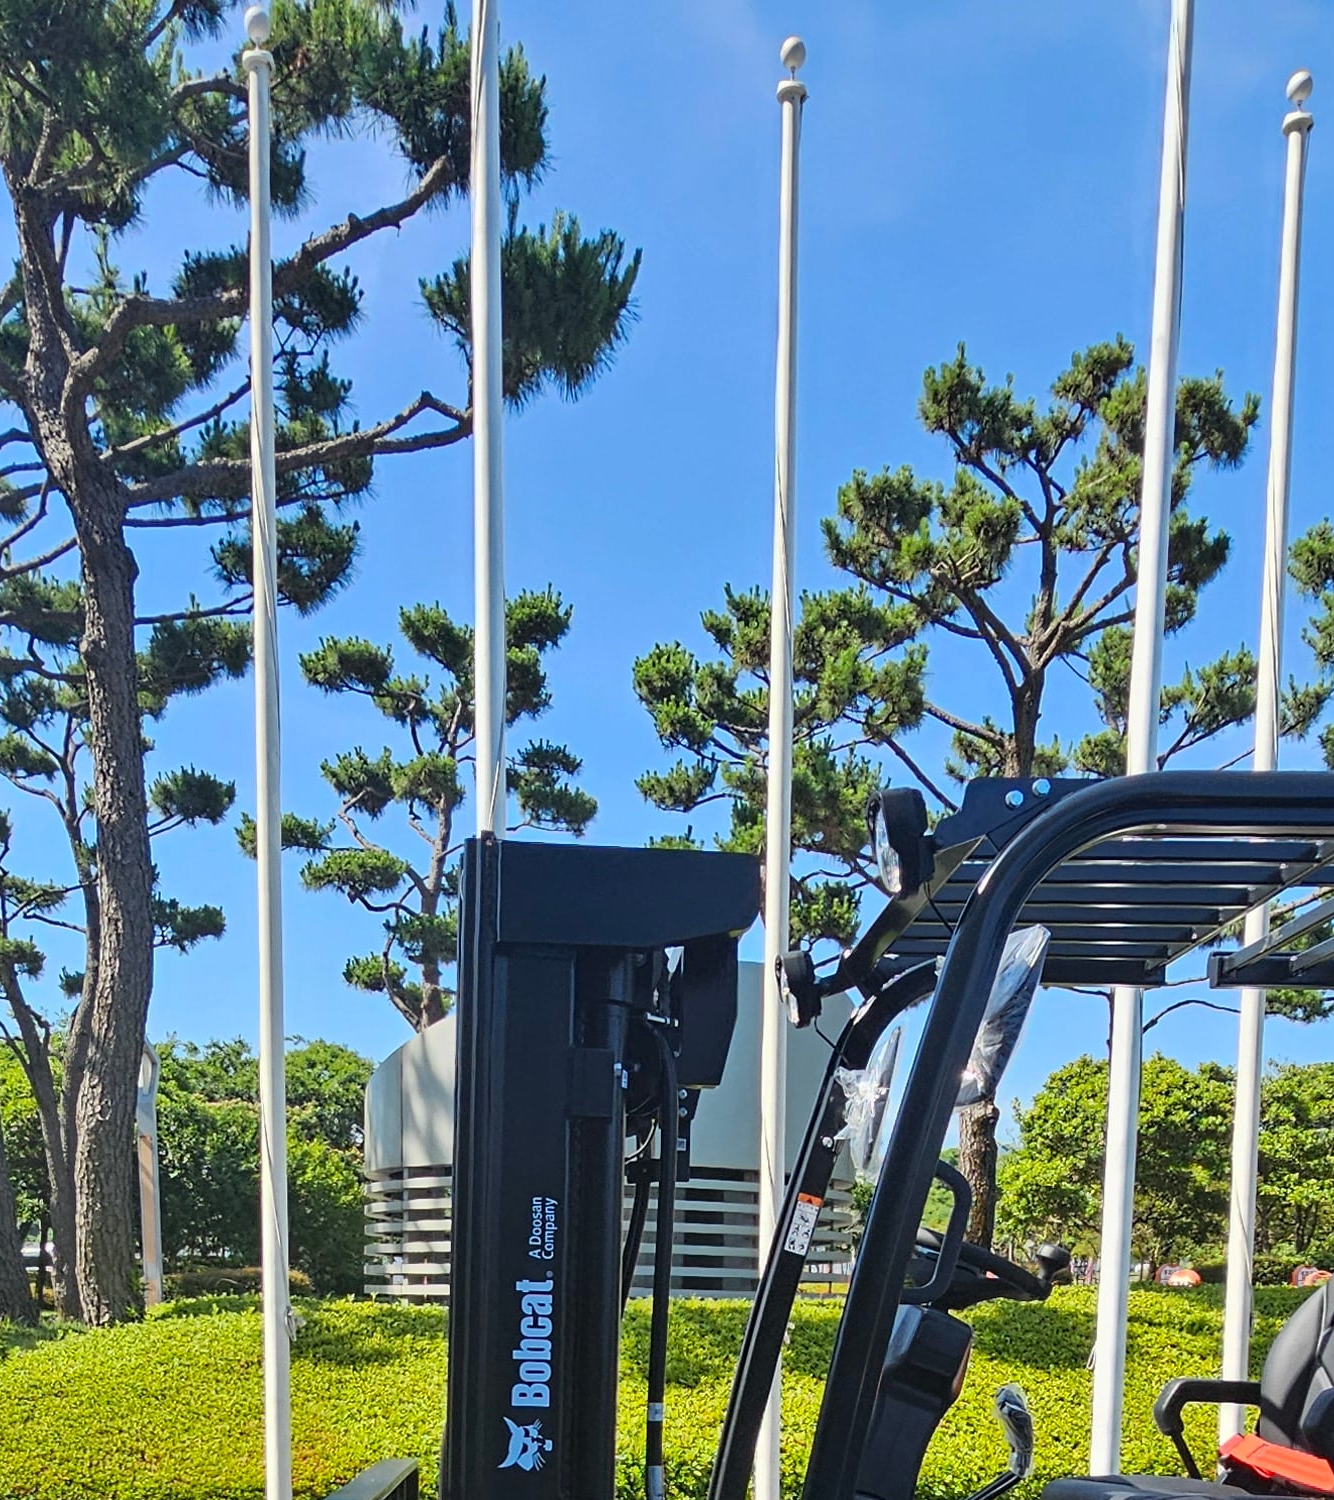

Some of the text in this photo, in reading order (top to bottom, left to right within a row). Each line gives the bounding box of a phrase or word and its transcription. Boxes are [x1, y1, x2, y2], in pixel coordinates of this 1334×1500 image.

[528, 1196, 543, 1259] A Doosan
[542, 1197, 558, 1260] Company
